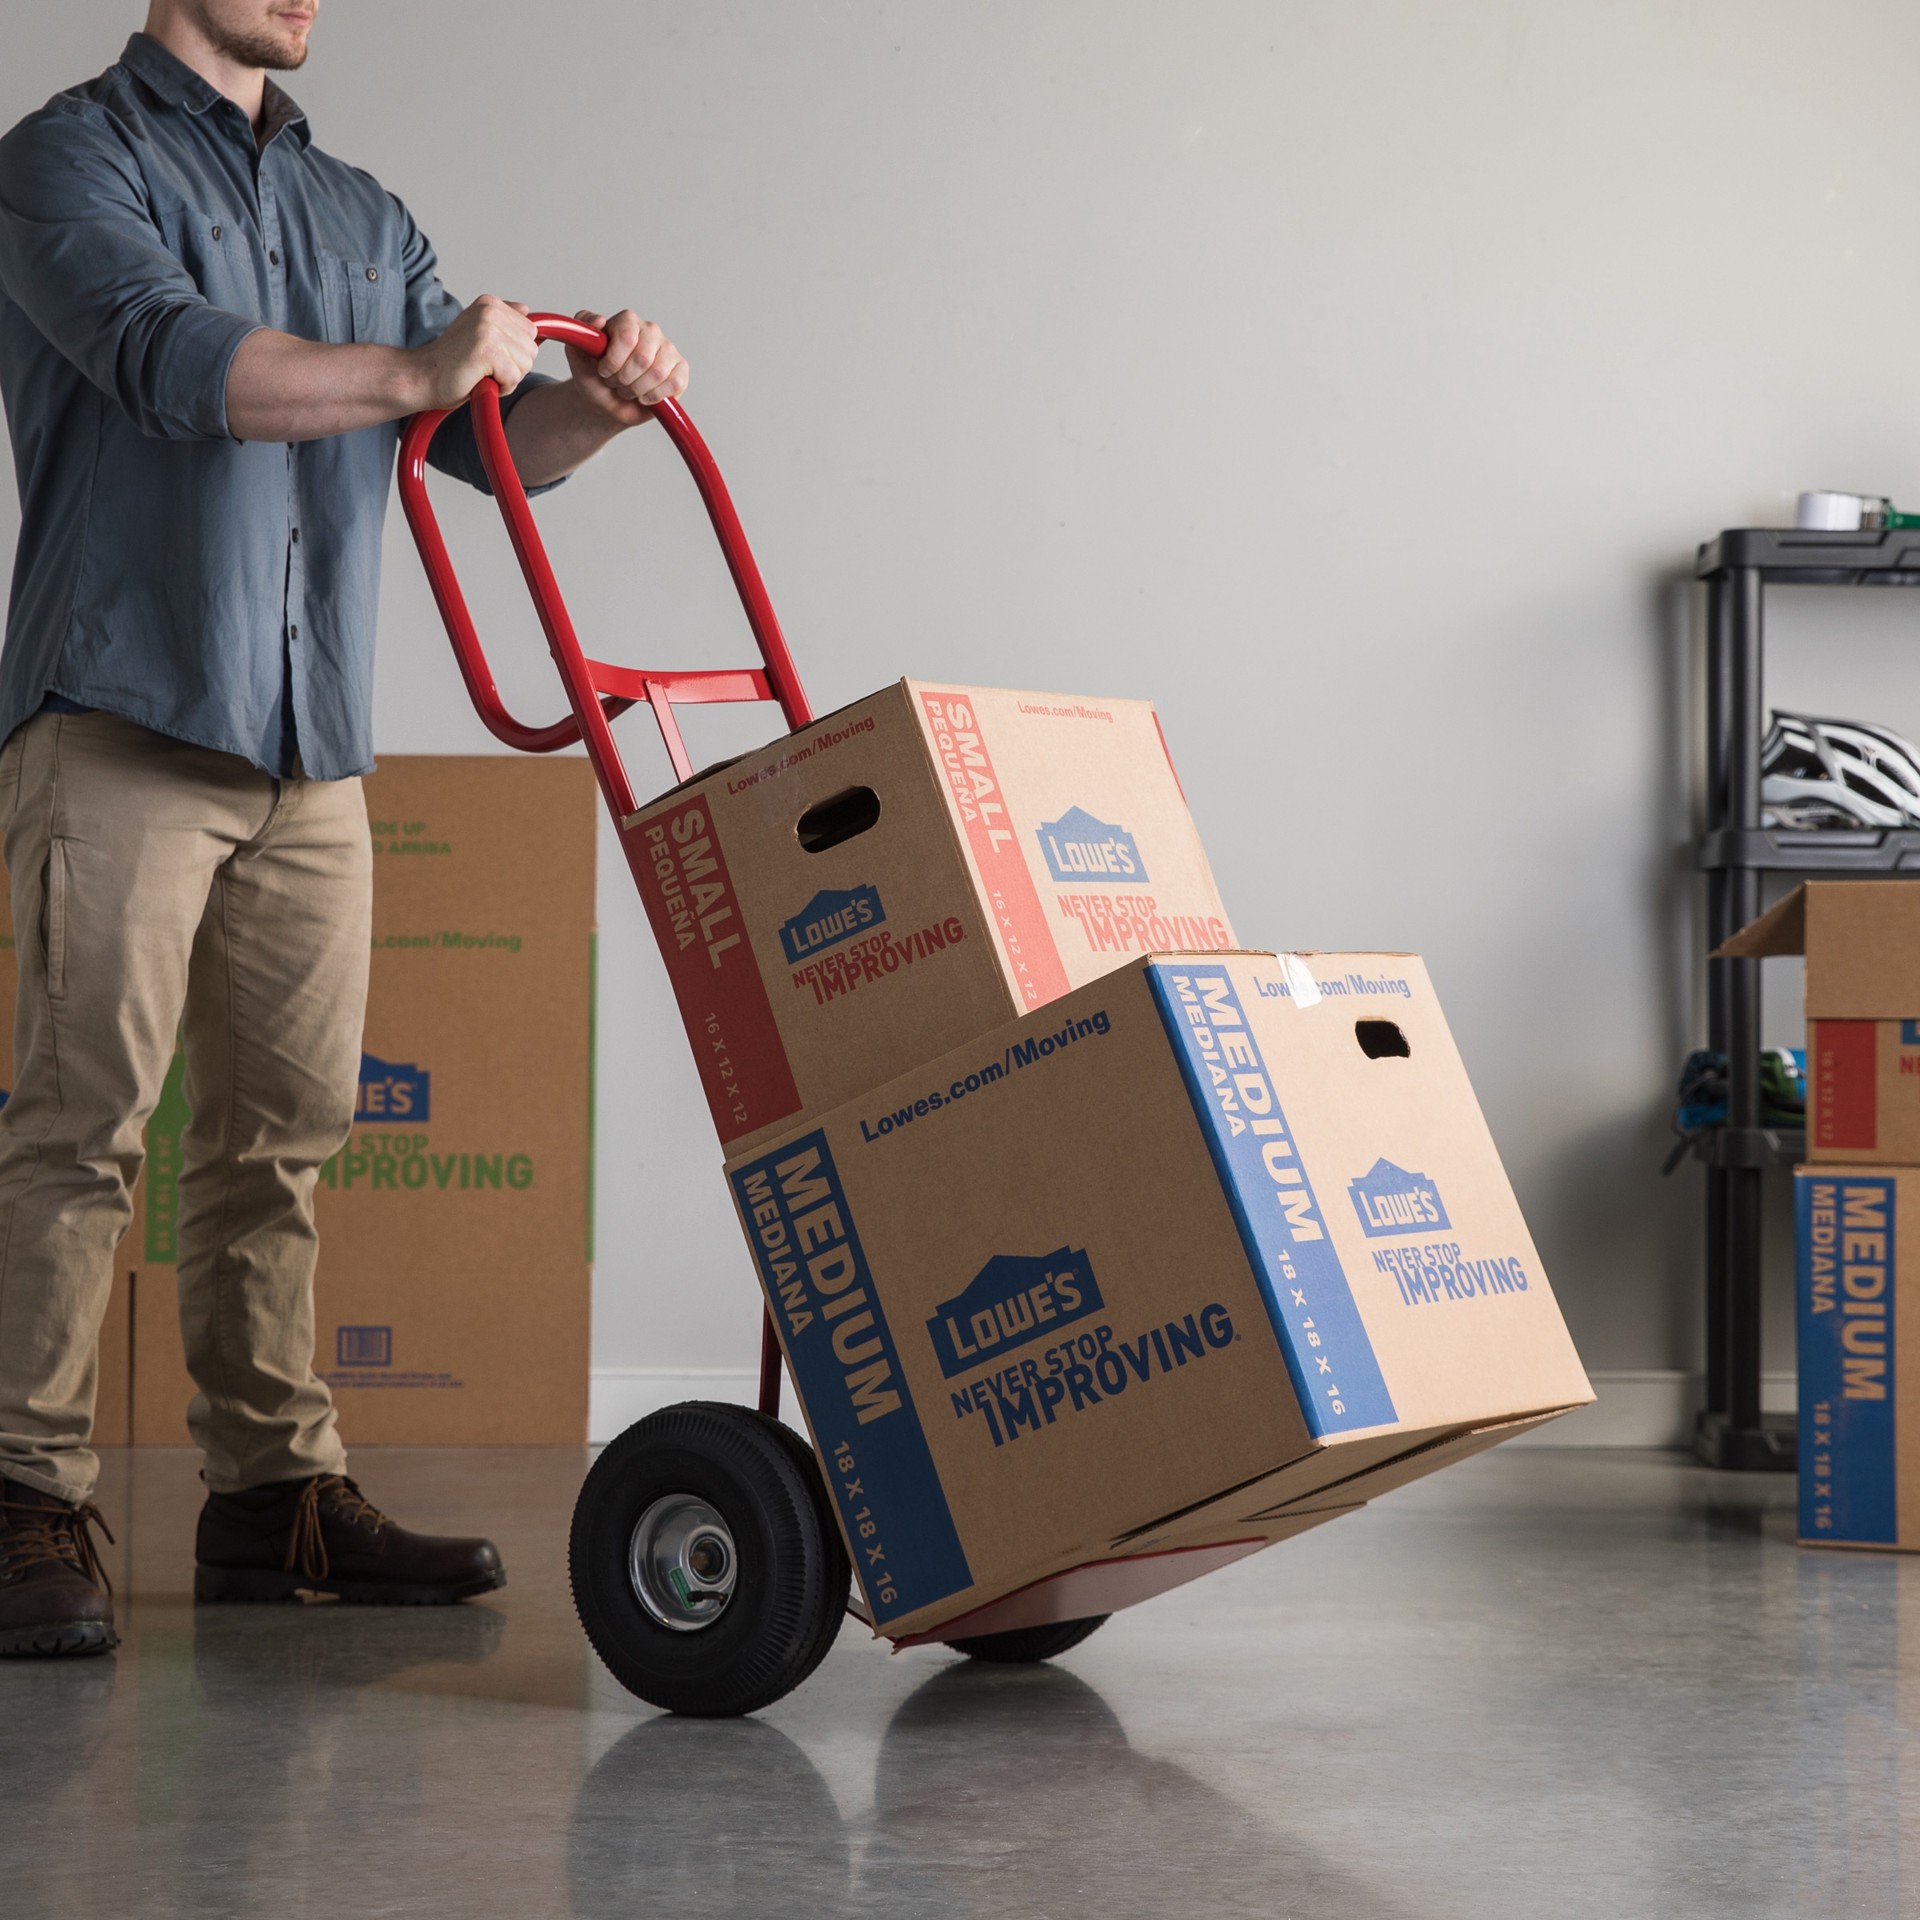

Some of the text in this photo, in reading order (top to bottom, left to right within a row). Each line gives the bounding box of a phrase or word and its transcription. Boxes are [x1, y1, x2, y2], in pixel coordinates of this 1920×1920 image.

[726, 716, 876, 796] Lowes.com/Moving
[925, 700, 978, 823] PEQUEÑA
[1016, 700, 1114, 724] Lowes.com/Moving
[946, 702, 1012, 854] SMALL
[644, 824, 697, 951] PEQUEÑA
[670, 808, 742, 970] SMALL
[1047, 835, 1136, 875] LOWE'S
[1056, 894, 1158, 919] NEVER STOP
[789, 898, 874, 954] LOWE'S
[791, 930, 892, 990] NEVER STOP
[809, 916, 965, 1006] IMPROVING
[992, 889, 1037, 1000] 16 X 12 X 12
[1078, 912, 1231, 953] IMPROVING
[705, 1012, 748, 1125] 16 X 12 X 12
[859, 1010, 1112, 1144] Lowes.com/Moving
[1171, 975, 1247, 1138] MEDIANA
[1194, 977, 1325, 1243] MEDIUM
[359, 1133, 429, 1155] STOP
[742, 1169, 814, 1337] MEDIANA
[1358, 1186, 1440, 1228] LOWE'S
[1371, 1242, 1461, 1273] NEVER STOP
[1811, 1184, 1836, 1315] MEDIANA
[774, 1145, 902, 1426] MEDIUM
[946, 1271, 1083, 1361] LOWE'S
[1278, 1249, 1346, 1416] 18 X 18 X 16
[1390, 1256, 1528, 1306] IMPROVING
[1841, 1187, 1887, 1400] MEDIUM
[950, 1324, 1114, 1419] NEVER STOP
[976, 1302, 1234, 1448] IMPROVING
[834, 1440, 898, 1604] 18 X 18 X 16
